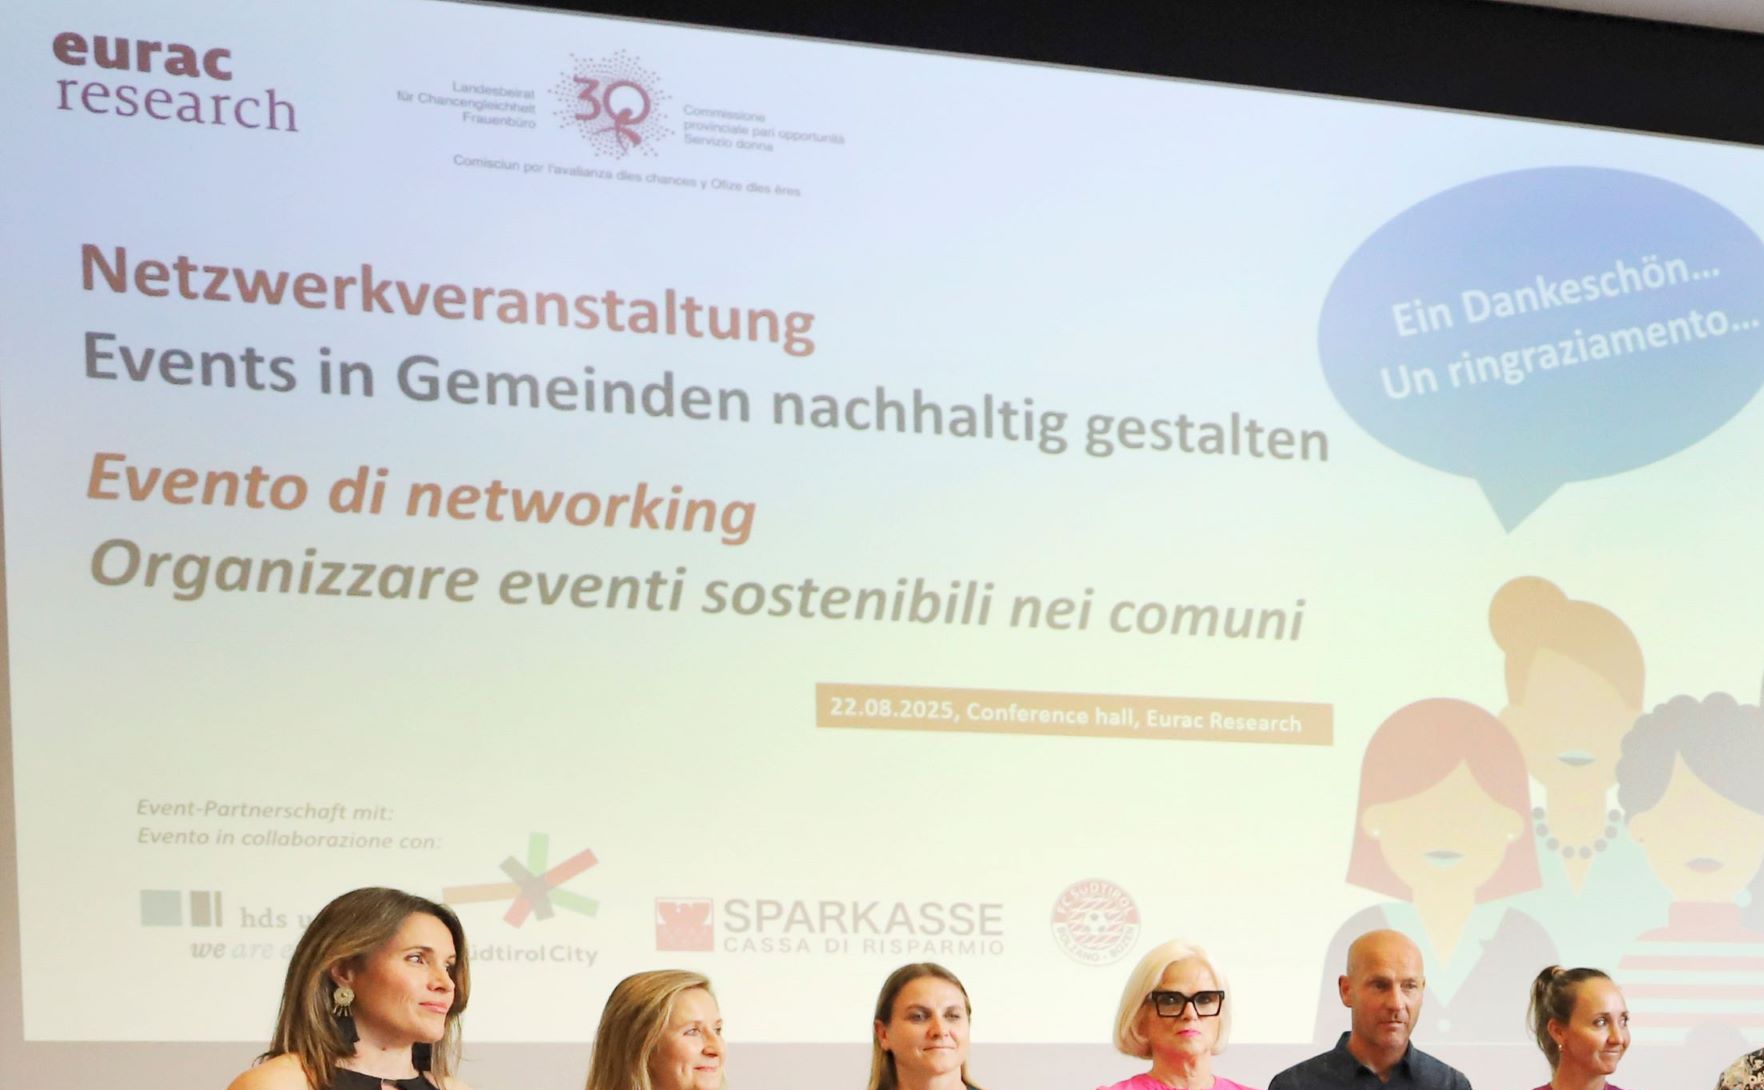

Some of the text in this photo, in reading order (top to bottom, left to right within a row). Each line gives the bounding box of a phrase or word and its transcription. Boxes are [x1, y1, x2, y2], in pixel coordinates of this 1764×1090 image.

[53, 30, 233, 82] eurac
[56, 75, 299, 132] research
[397, 90, 536, 114] für Chancengleichheit
[452, 80, 535, 100] Landesbeirat
[462, 111, 536, 129] Frauenbüro
[683, 104, 766, 122] Commissione
[684, 121, 749, 136] provinciale
[752, 126, 775, 138] pari
[684, 133, 774, 152] Servizio donna
[453, 153, 519, 171] Comisciun
[523, 162, 543, 174] por
[617, 170, 642, 183] dies
[645, 173, 697, 188] chances
[746, 181, 771, 194] dies
[80, 242, 816, 358] Netzwerkveranstaltung
[1392, 254, 1721, 338] Ein Dankeschön...
[1380, 307, 1760, 401] Un ringraziamento...
[84, 331, 1330, 462] Events in Gemeinden nachhaltig gestalten
[87, 451, 757, 547] Evento di networking
[90, 537, 1308, 642] Organizzare eventi sostenibili nei comuni
[829, 696, 1302, 734] 22.08.2025, Conference hall, Eurac Research
[136, 799, 394, 824] Event-Partnerschaft mit:
[137, 827, 442, 851] Evento in collaborazione con:
[240, 906, 287, 928] hds
[723, 898, 1004, 937] SPARKASSE
[191, 942, 226, 959] we
[723, 936, 1004, 957] CASSA DI RISPARMIO
